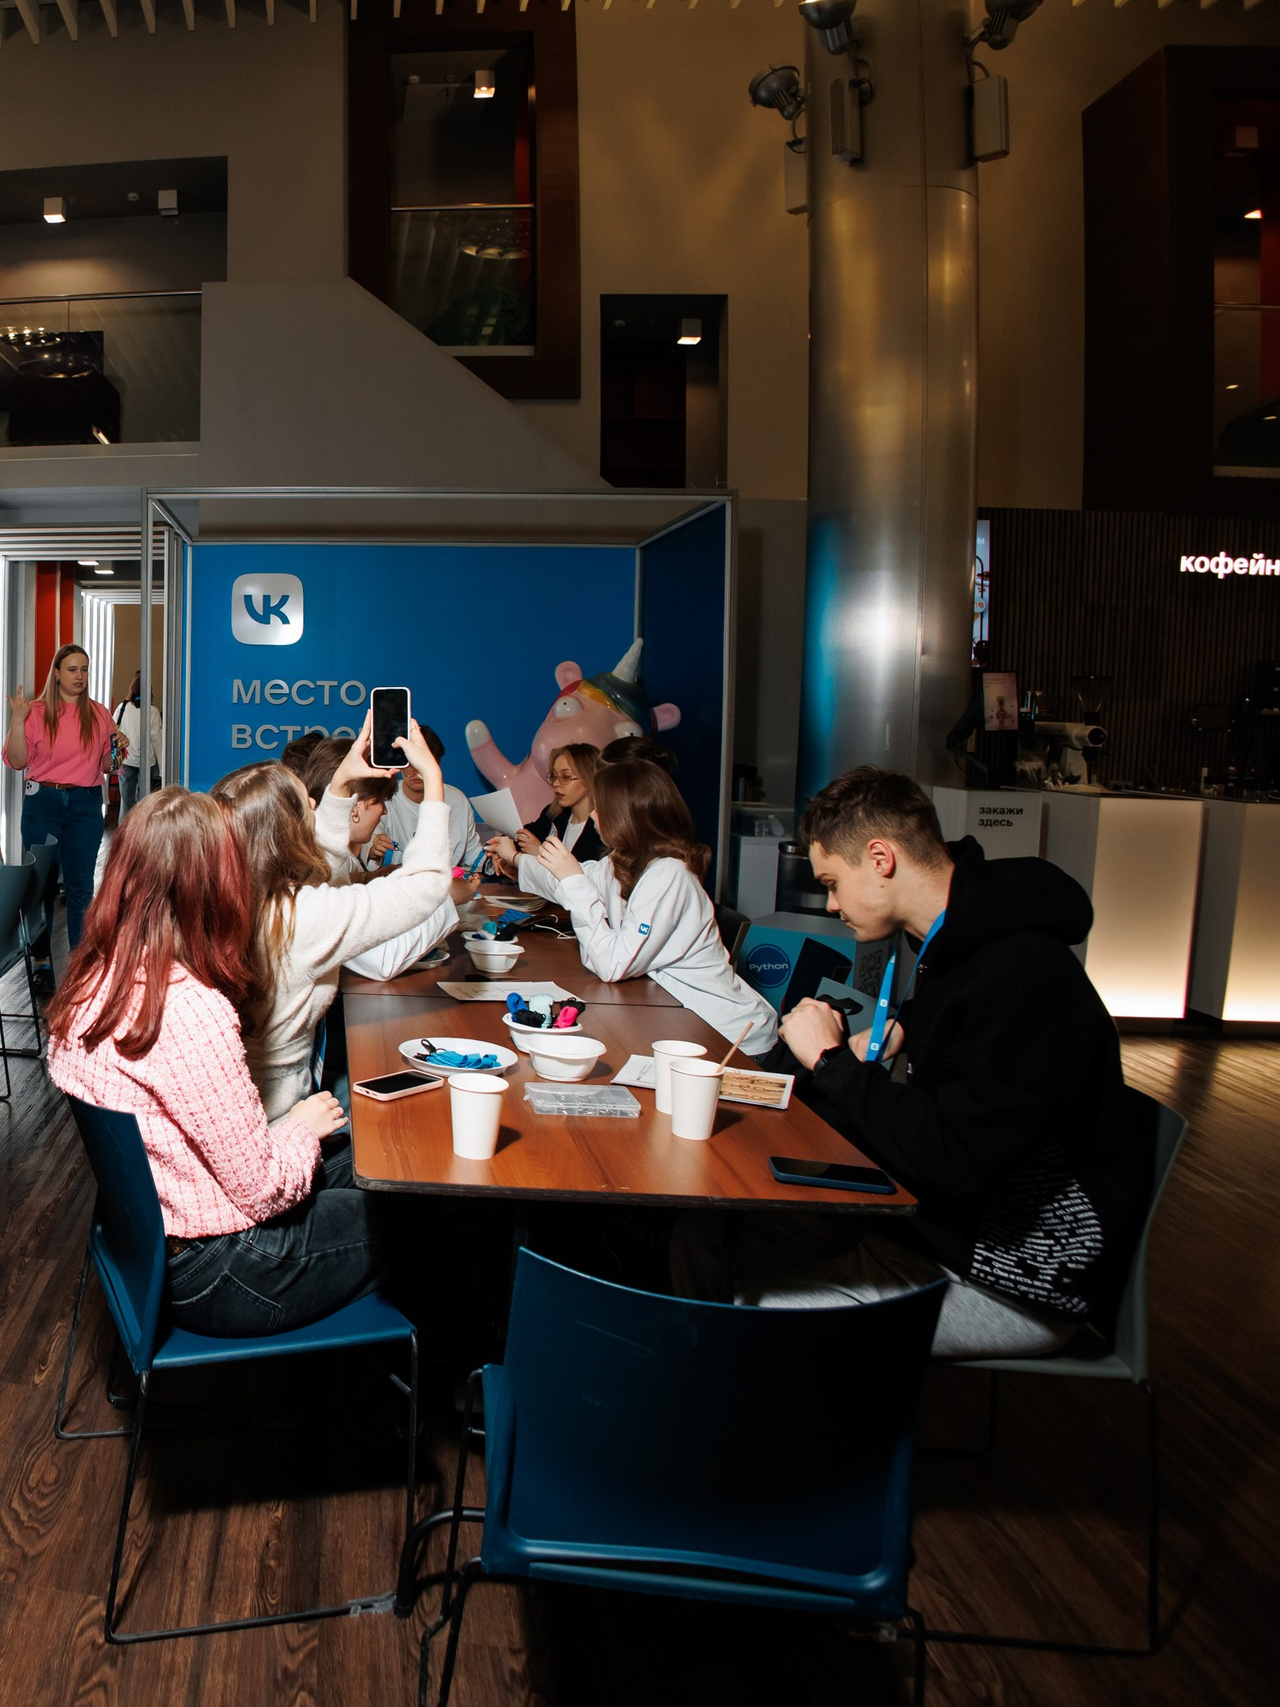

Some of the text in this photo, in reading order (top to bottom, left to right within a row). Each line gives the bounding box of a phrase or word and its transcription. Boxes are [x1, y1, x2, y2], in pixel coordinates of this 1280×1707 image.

[243, 594, 291, 625] VK
[231, 678, 367, 706] место
[979, 806, 1024, 815] закажи
[978, 818, 1013, 828] здесь
[748, 962, 789, 972] Python
